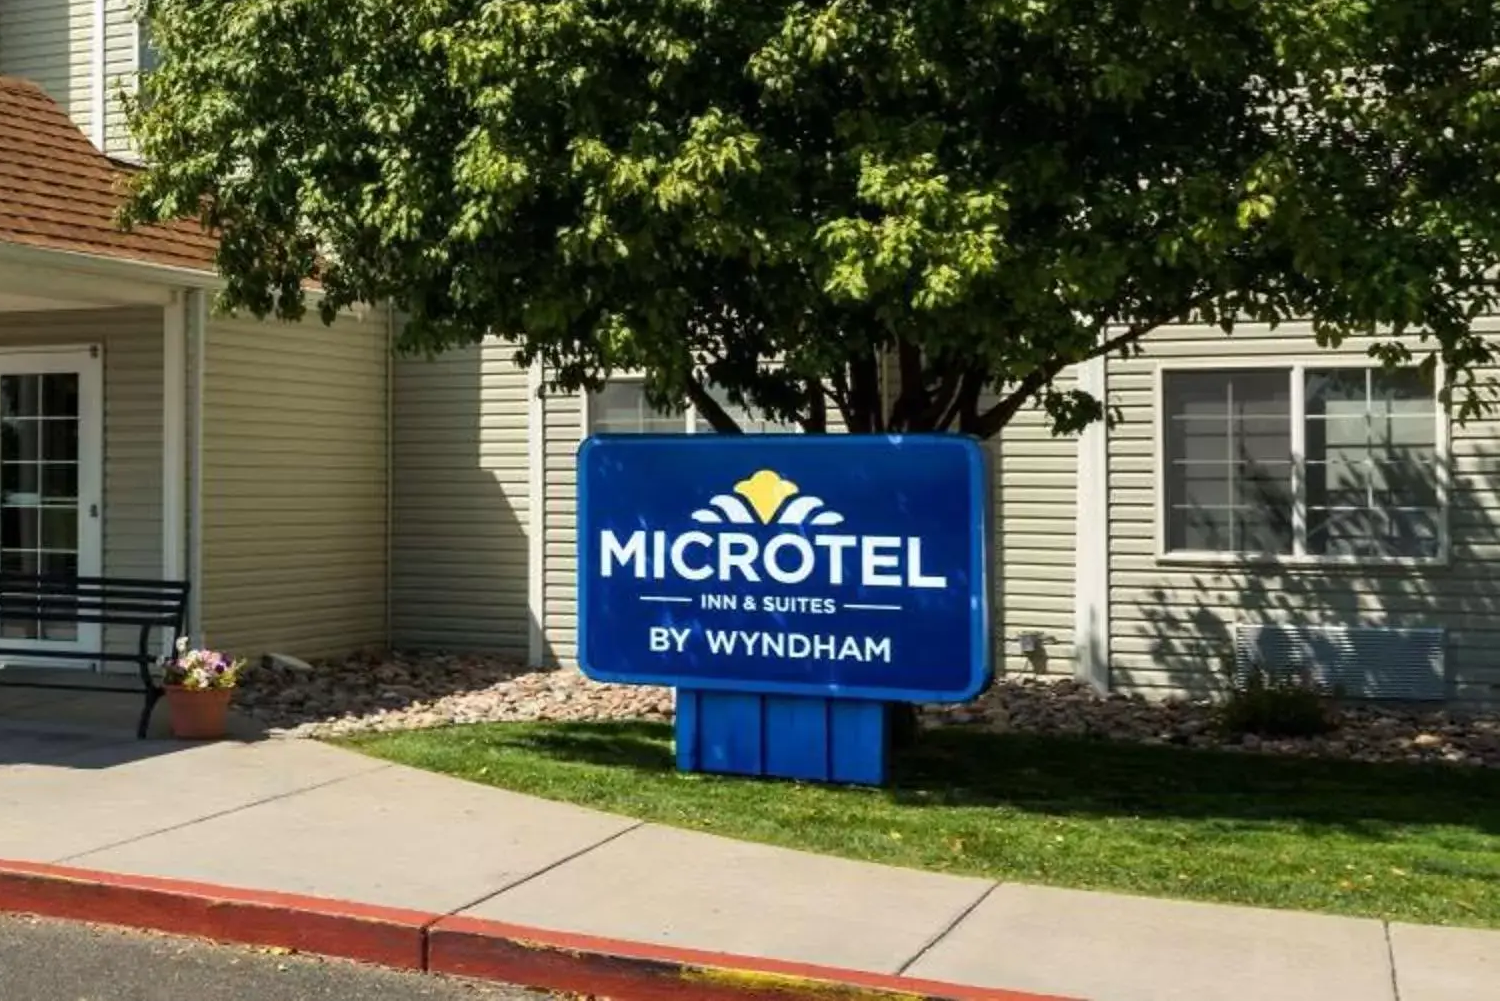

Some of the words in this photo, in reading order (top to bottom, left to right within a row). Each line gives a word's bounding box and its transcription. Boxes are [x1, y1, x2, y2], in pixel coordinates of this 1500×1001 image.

[600, 529, 948, 588] MICROTEL
[701, 594, 737, 611] INN
[743, 598, 757, 612] &
[763, 596, 836, 615] SUITES
[649, 627, 692, 653] BY
[706, 629, 892, 663] WYNDHAM
